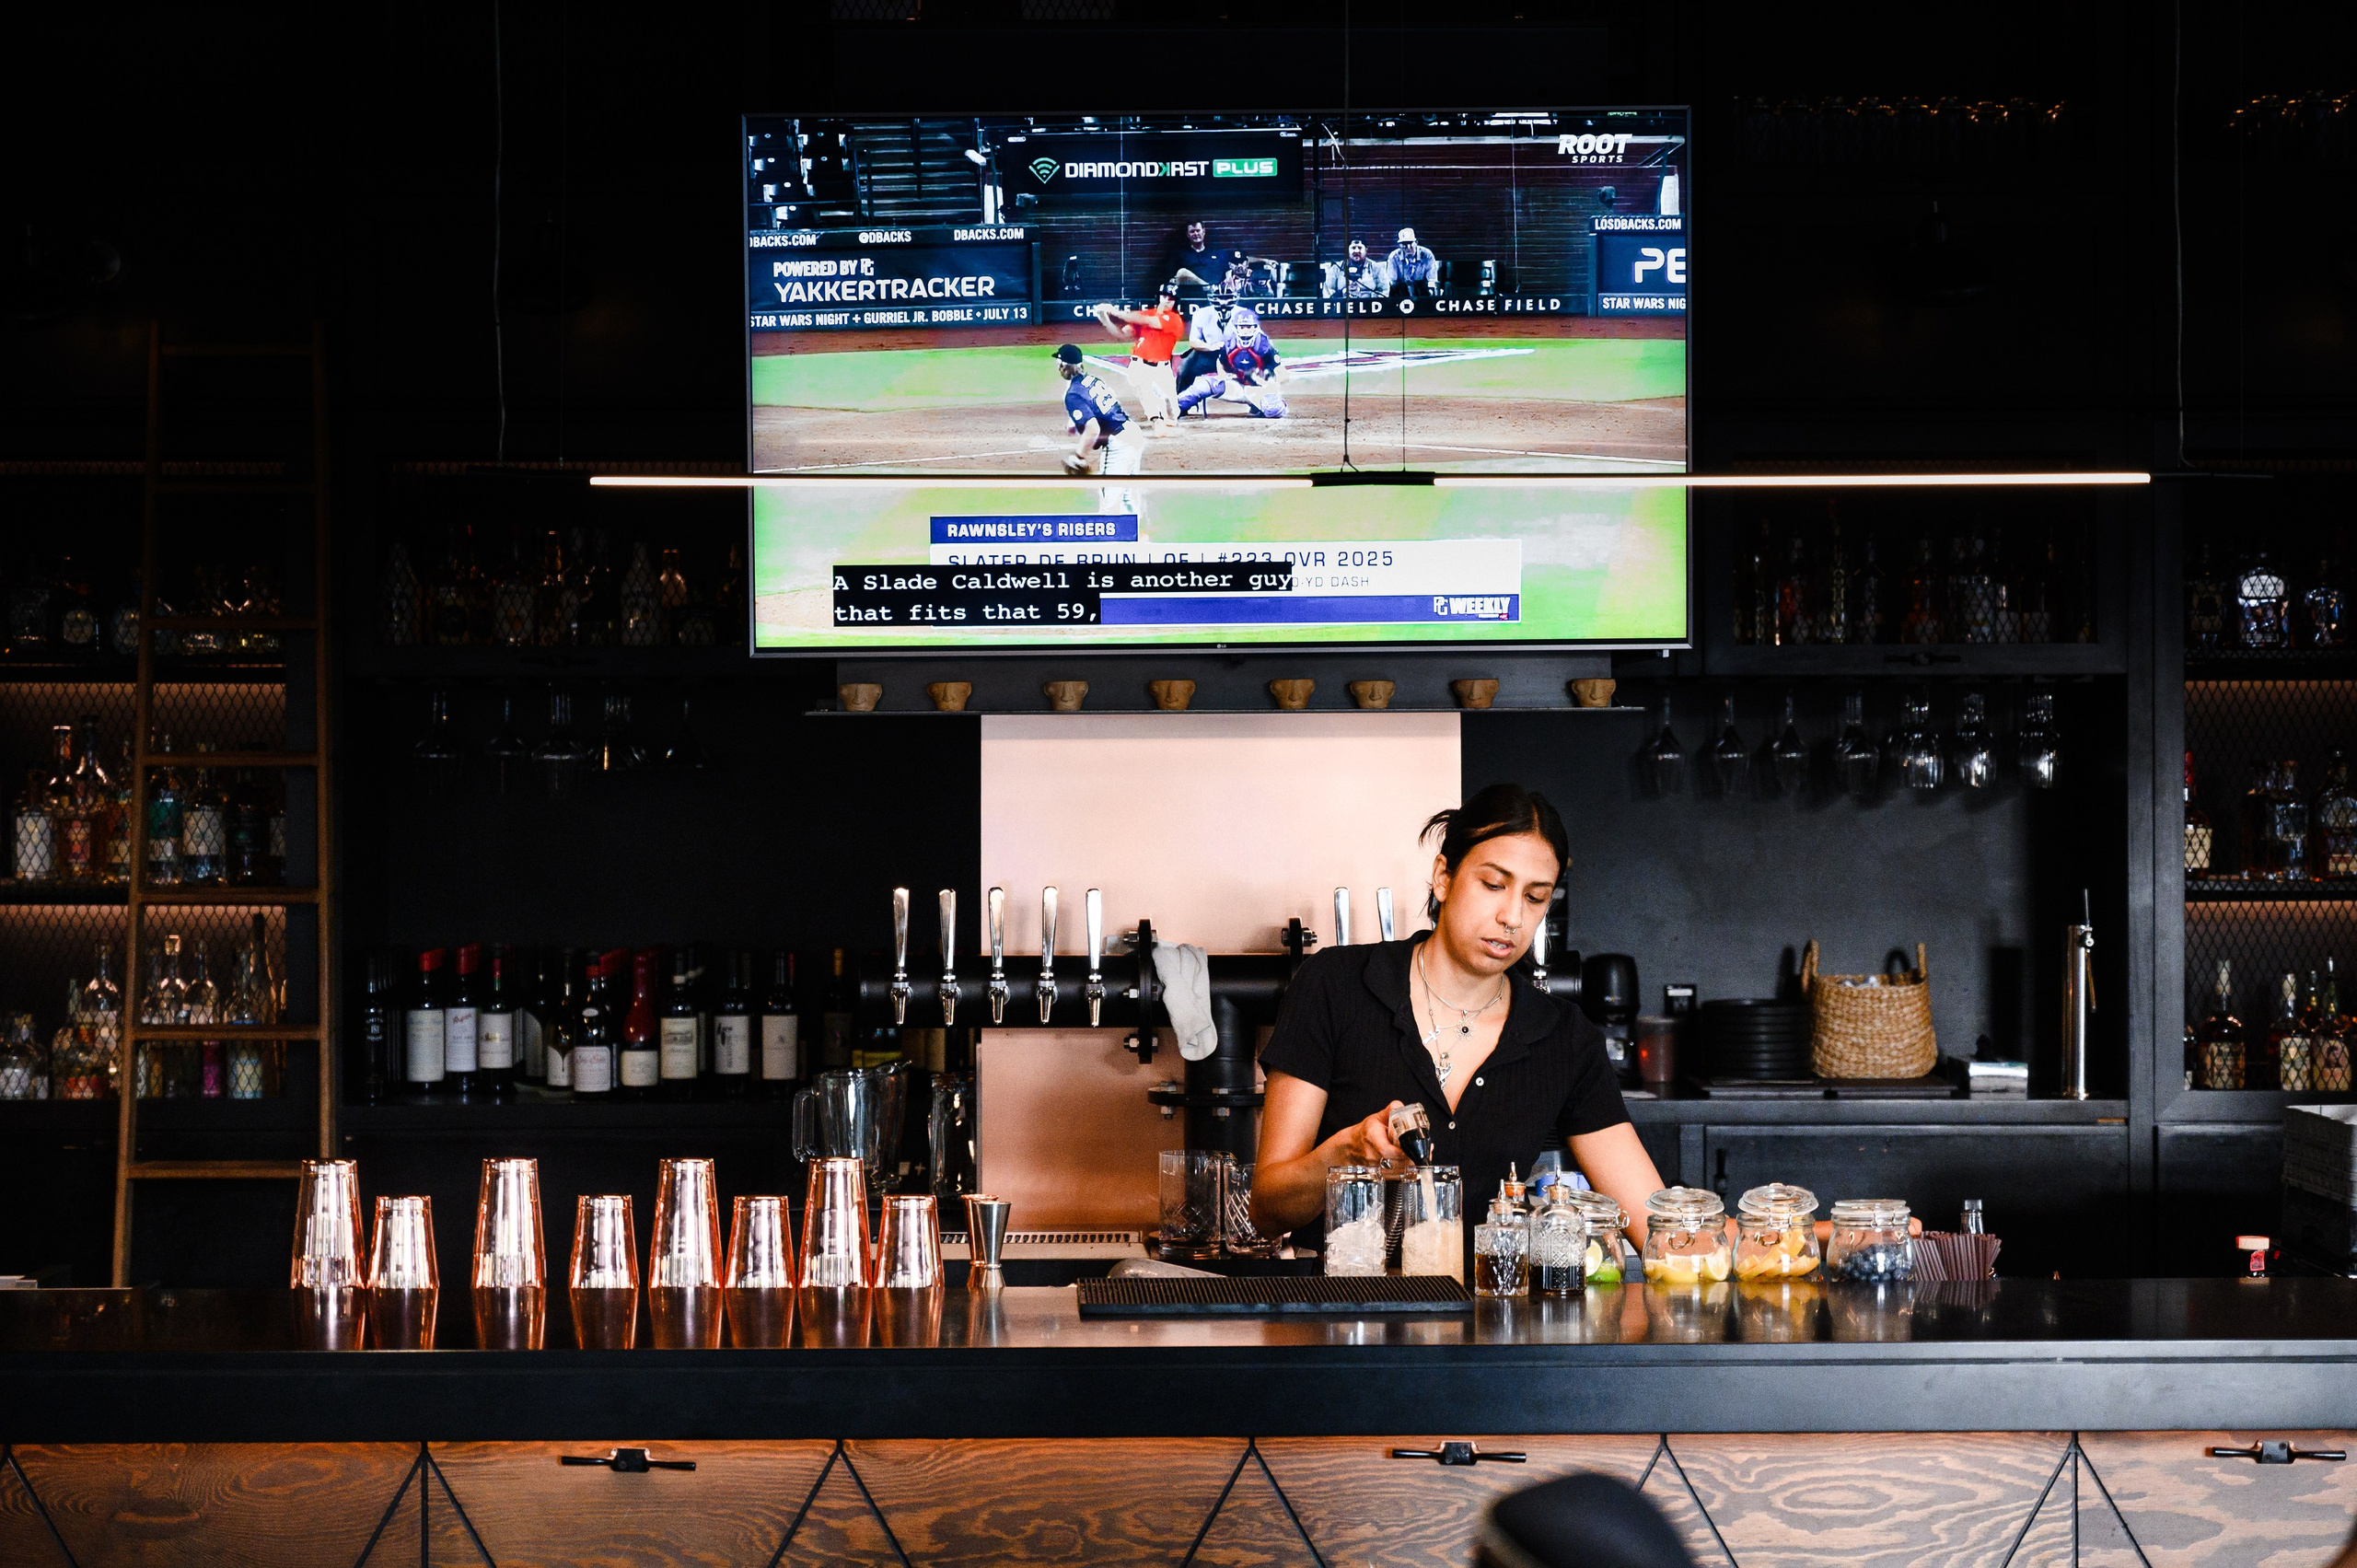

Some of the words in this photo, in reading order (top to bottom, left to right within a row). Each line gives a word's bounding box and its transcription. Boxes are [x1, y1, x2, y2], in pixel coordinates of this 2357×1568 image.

[1558, 134, 1632, 154] ROOT
[1572, 155, 1623, 163] SPORTS
[1216, 161, 1274, 174] PLUS
[859, 231, 912, 244] @DBACKS
[954, 228, 1024, 241] DBACKS.COM
[773, 261, 838, 277] POWERED
[840, 260, 858, 275] BY
[1634, 248, 1686, 284] PE
[773, 275, 995, 303] YAKKERTRACKER
[1254, 302, 1315, 315] CHASE
[1323, 301, 1383, 314] FIELD
[1435, 299, 1495, 312] CHASE
[1504, 298, 1561, 311] FIELD
[1602, 297, 1631, 309] STAR
[1633, 297, 1666, 310] WARS
[779, 314, 812, 327] WARS
[815, 313, 850, 326] NIGHT
[864, 311, 910, 324] GURRIEL
[912, 310, 928, 323] JR.
[931, 309, 973, 322] BOBBLE
[982, 308, 1009, 320] JULY
[1014, 307, 1028, 319] 13
[947, 524, 1052, 537] RAWNSLEY'S
[1058, 523, 1116, 536] RISERS
[1285, 552, 1326, 566] OVR
[1338, 551, 1393, 566] 2025
[833, 575, 849, 590] A
[864, 575, 937, 590] Slade
[952, 573, 1070, 589] Caldwell
[1086, 571, 1114, 587] is
[1131, 569, 1234, 587] another
[1248, 573, 1292, 590] guy
[1330, 576, 1369, 587] DASH
[834, 605, 893, 621] that
[910, 604, 966, 620] fits
[982, 603, 1041, 619] that
[1058, 602, 1097, 621] 59,
[1449, 598, 1510, 614] WEEKLY
